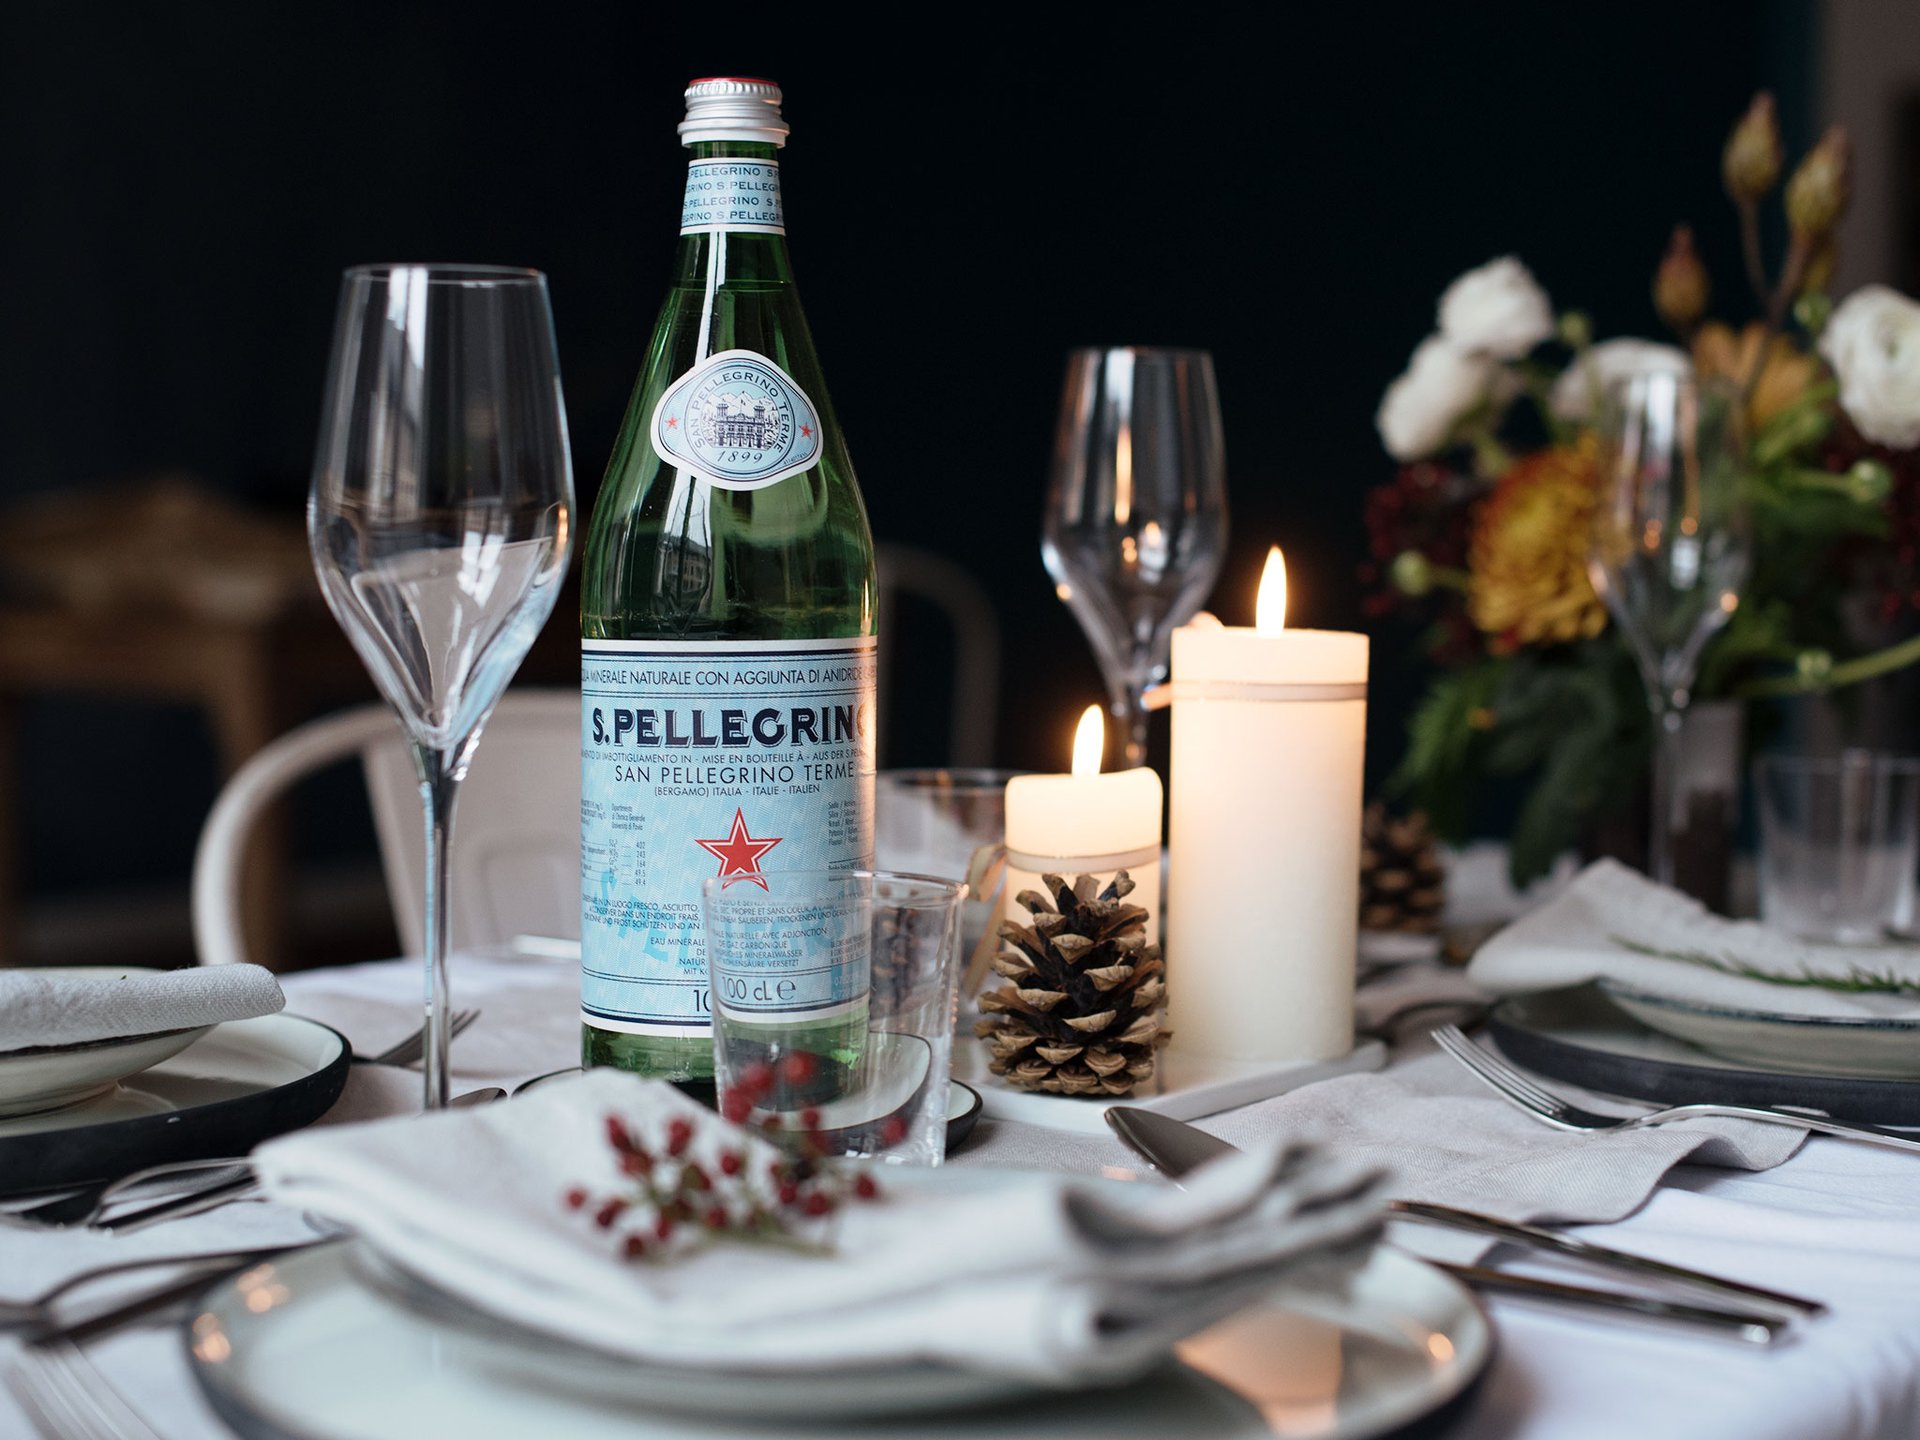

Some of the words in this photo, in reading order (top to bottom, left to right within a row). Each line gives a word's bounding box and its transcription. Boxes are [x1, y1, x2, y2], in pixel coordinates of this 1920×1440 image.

[692, 371, 779, 412] PELLEGRINO
[688, 418, 706, 449] SAN
[774, 401, 790, 453] TERME
[717, 450, 764, 464] 1899
[630, 670, 691, 685] NATURALE
[695, 671, 730, 686] CON
[733, 670, 805, 685] AGGIUNTA
[809, 669, 820, 683] DI
[681, 754, 692, 763] IN
[701, 754, 725, 764] MISE
[729, 754, 743, 763] EN
[746, 753, 794, 763] BOUTEILLE
[812, 751, 829, 761] AUS
[615, 765, 650, 782] SAN
[661, 766, 794, 784] PELLEGRINO
[804, 761, 854, 781] TERME
[654, 786, 710, 797] (BERGAMO)
[712, 786, 742, 796] ITALIA
[752, 786, 779, 796] ITALIE
[789, 784, 820, 795] ITALIEN
[669, 921, 686, 930] UND
[687, 922, 700, 930] AN
[762, 931, 780, 940] AVEC
[782, 927, 828, 939] ADJONCTION
[650, 936, 666, 946] EAU
[740, 940, 787, 950] CARBONIQUE
[683, 967, 697, 975] MIT
